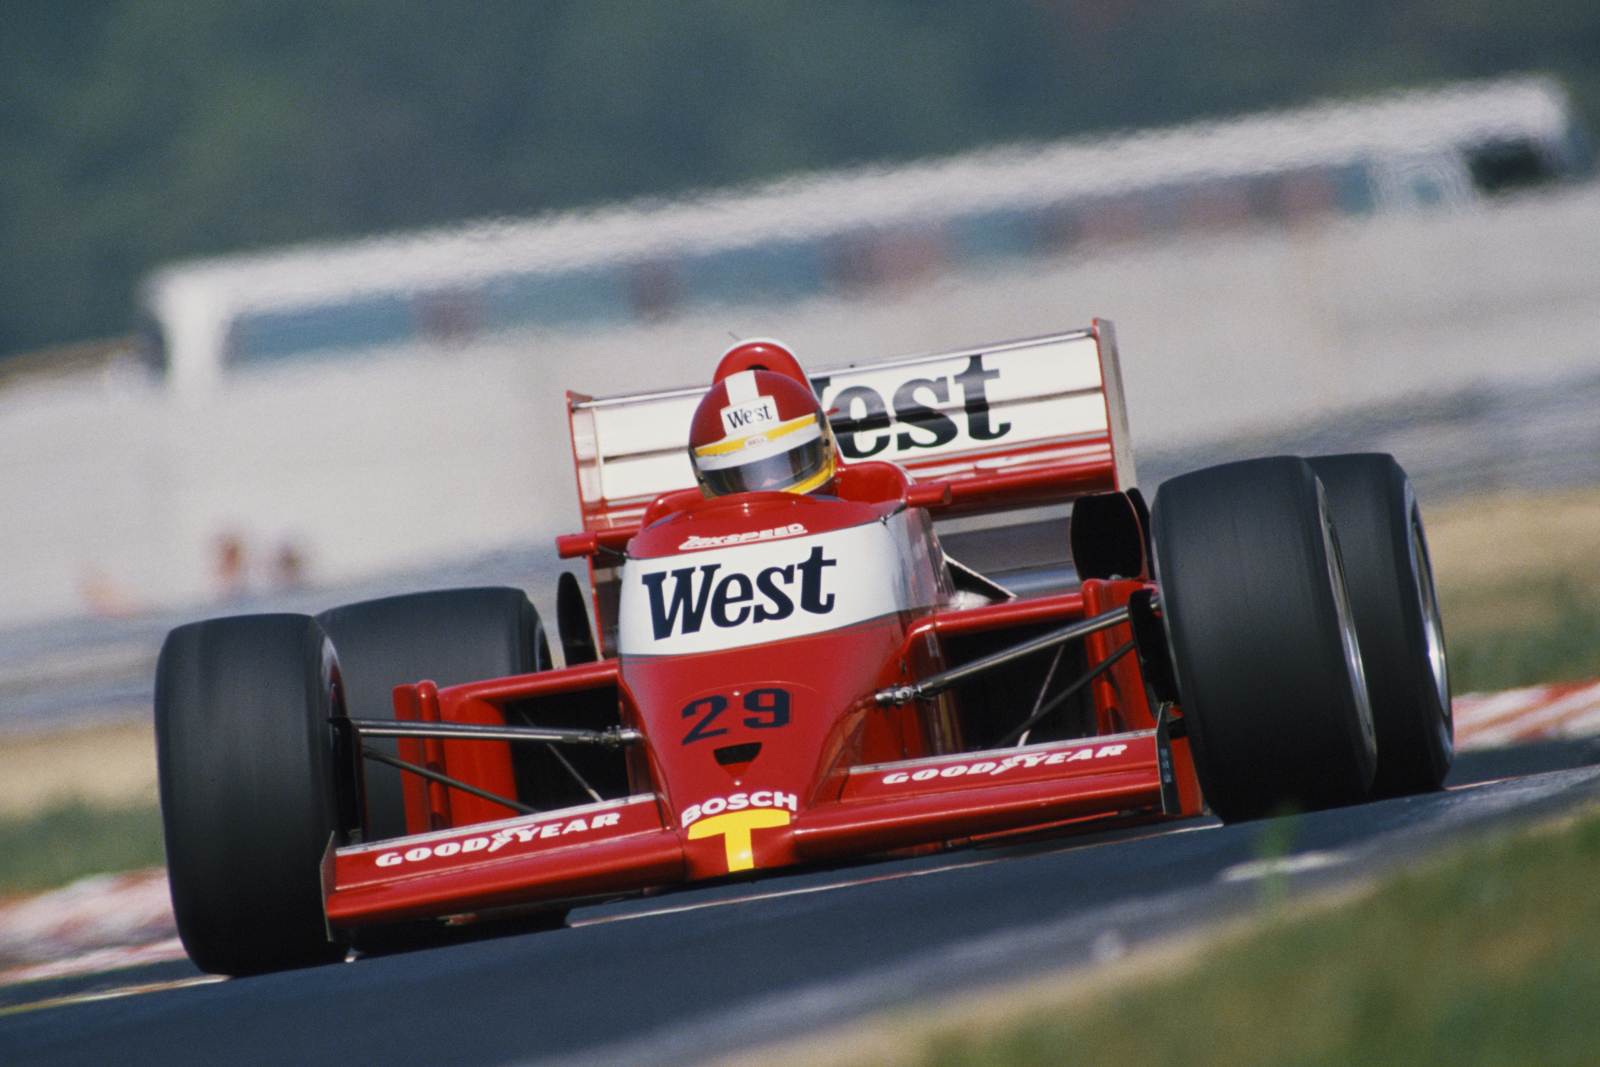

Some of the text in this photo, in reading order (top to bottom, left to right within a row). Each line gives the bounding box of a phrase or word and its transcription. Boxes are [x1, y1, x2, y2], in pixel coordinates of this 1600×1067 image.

[726, 404, 773, 429] West
[641, 546, 837, 641] West
[681, 688, 790, 746] 29
[882, 744, 1128, 785] GOODYEAR
[681, 790, 798, 829] BOSCH
[375, 812, 621, 867] GOODYEAR
